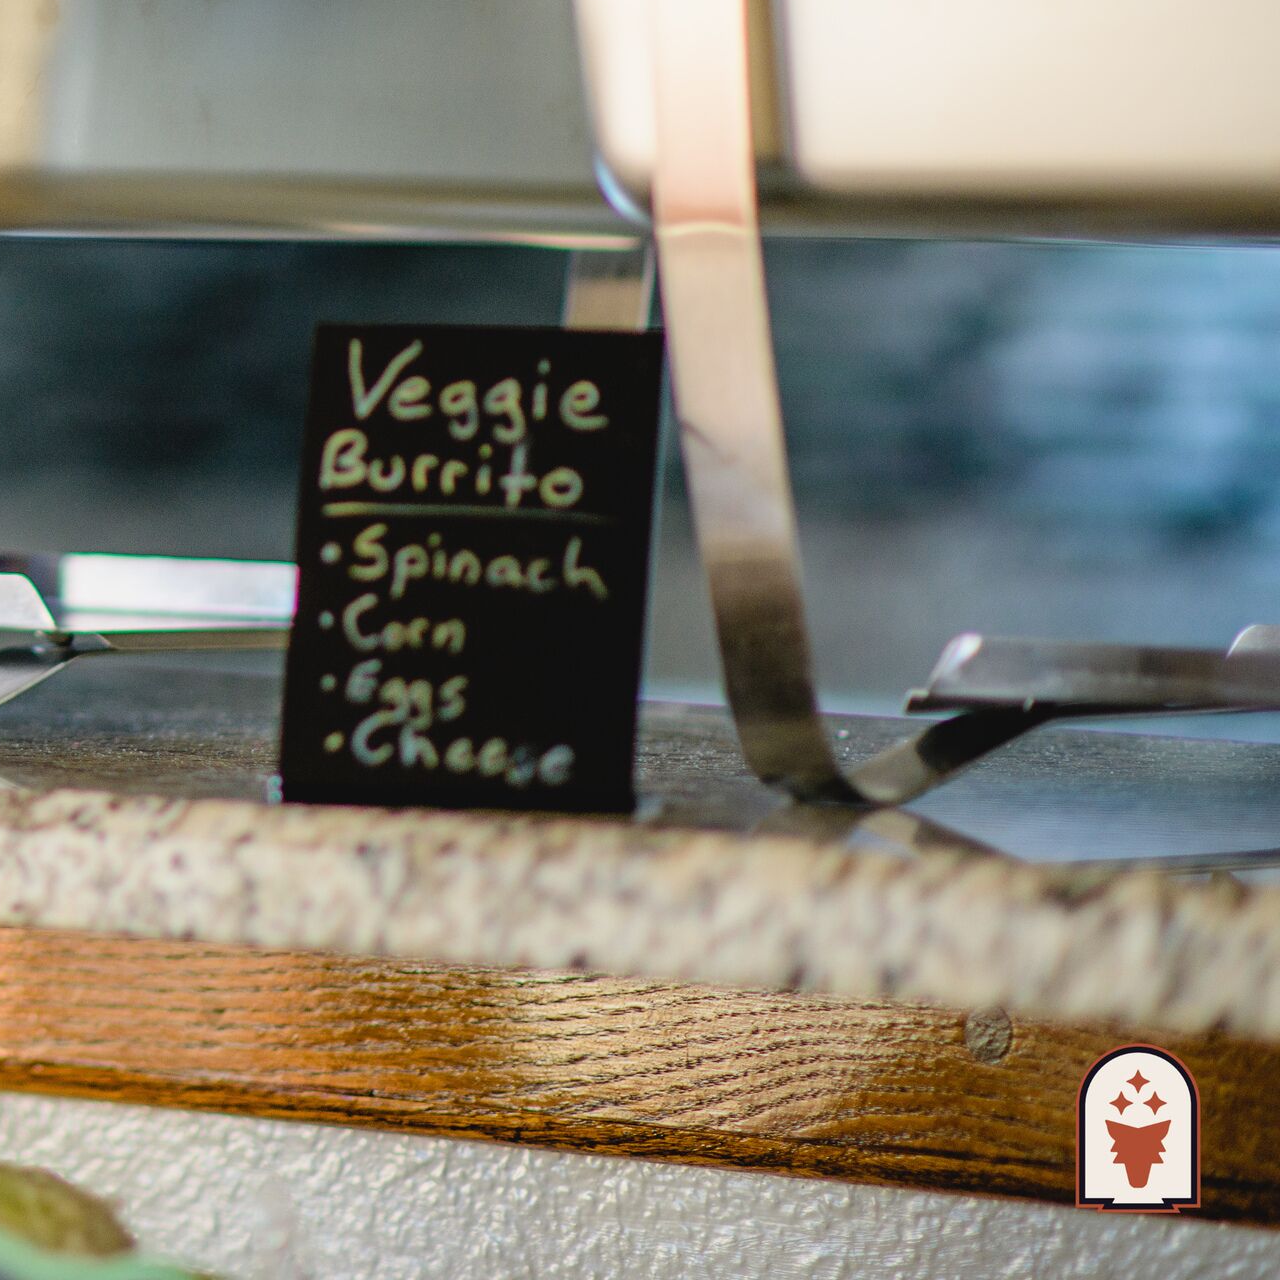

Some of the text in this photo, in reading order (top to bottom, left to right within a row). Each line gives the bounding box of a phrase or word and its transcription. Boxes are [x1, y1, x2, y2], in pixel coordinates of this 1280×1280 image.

[348, 338, 609, 444] Veggie
[319, 427, 584, 508] Burrito
[349, 523, 609, 599] Spinach
[343, 592, 467, 653] Corn
[344, 658, 468, 729] Eggs
[350, 708, 576, 785] Cheese
